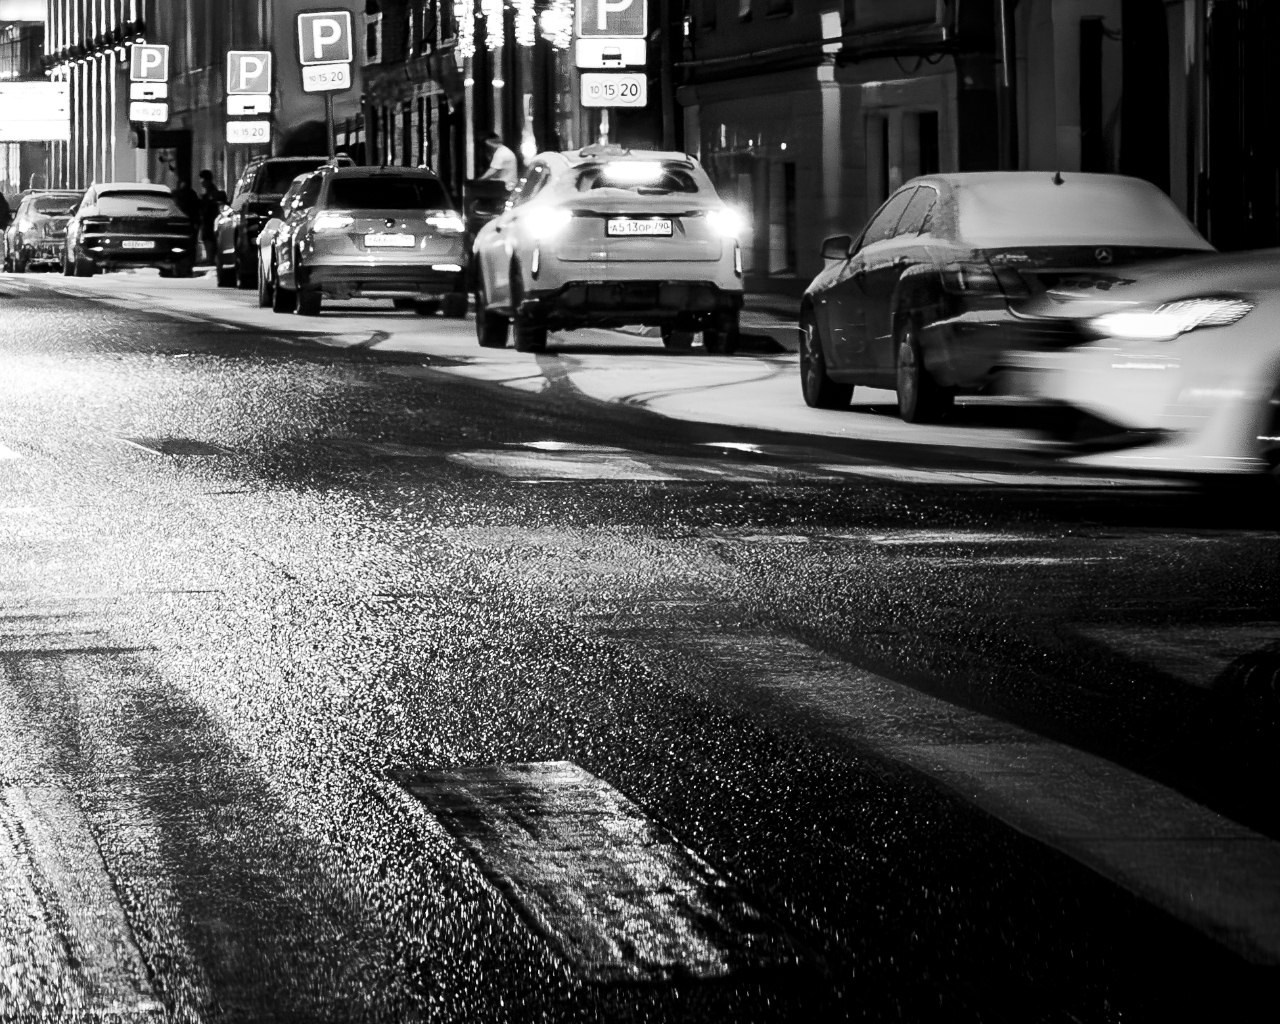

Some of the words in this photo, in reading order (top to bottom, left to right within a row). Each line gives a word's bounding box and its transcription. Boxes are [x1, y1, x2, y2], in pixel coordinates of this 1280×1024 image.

[312, 19, 341, 59] P
[141, 49, 162, 77] P
[239, 56, 263, 89] P
[331, 71, 344, 82] 20
[590, 85, 600, 94] 10
[604, 84, 615, 95] 15
[620, 83, 638, 96] 20
[252, 127, 264, 136] 20
